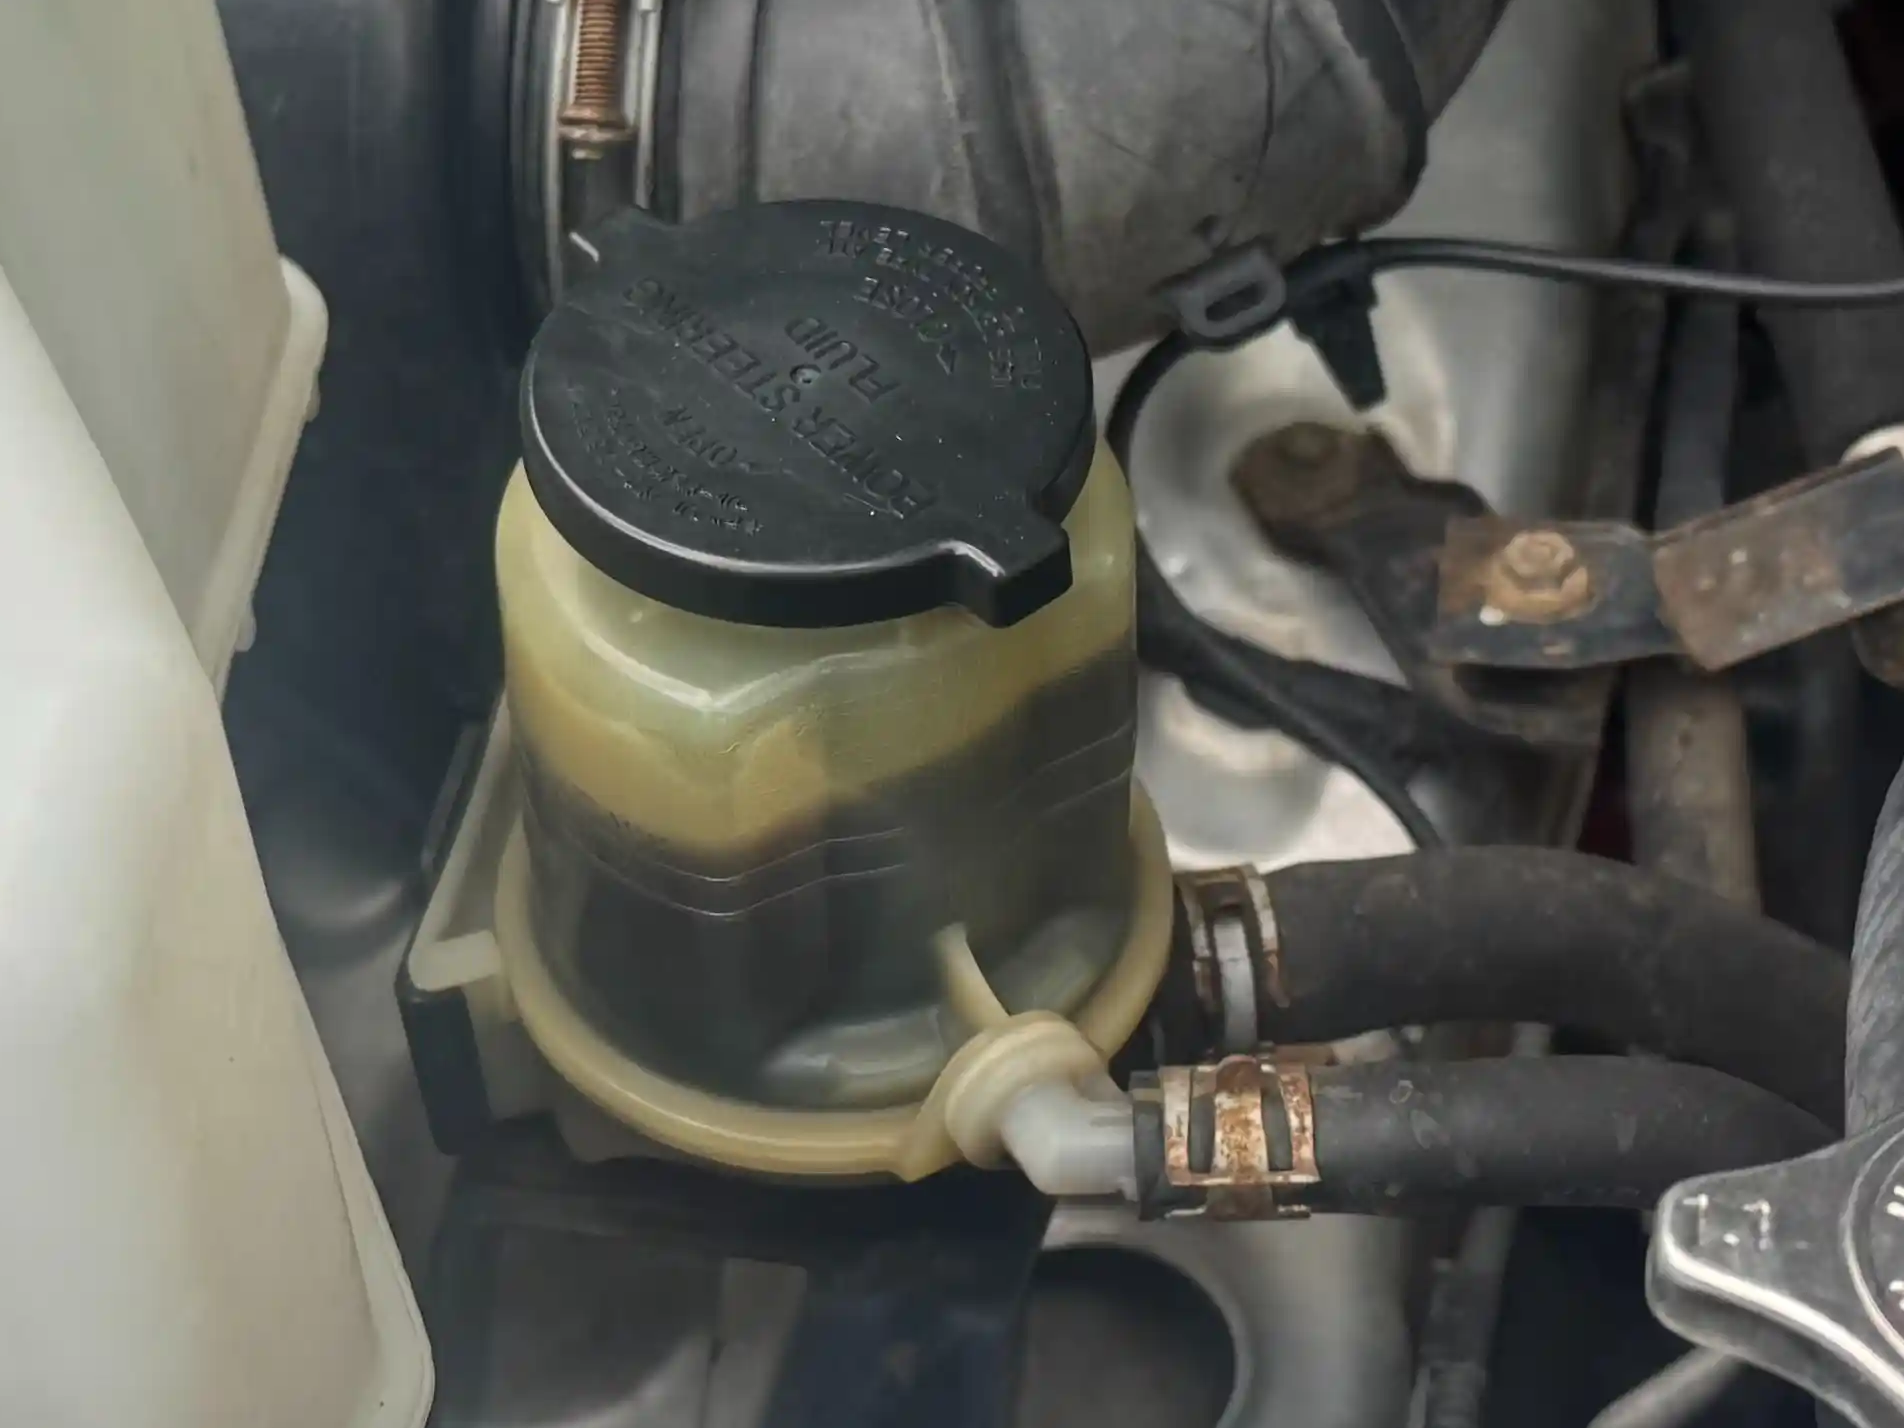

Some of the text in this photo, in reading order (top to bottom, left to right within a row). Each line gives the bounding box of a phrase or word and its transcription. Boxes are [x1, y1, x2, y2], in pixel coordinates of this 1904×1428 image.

[622, 276, 802, 414] STEERING
[782, 315, 902, 405] FLUID
[792, 404, 938, 520] POWER
